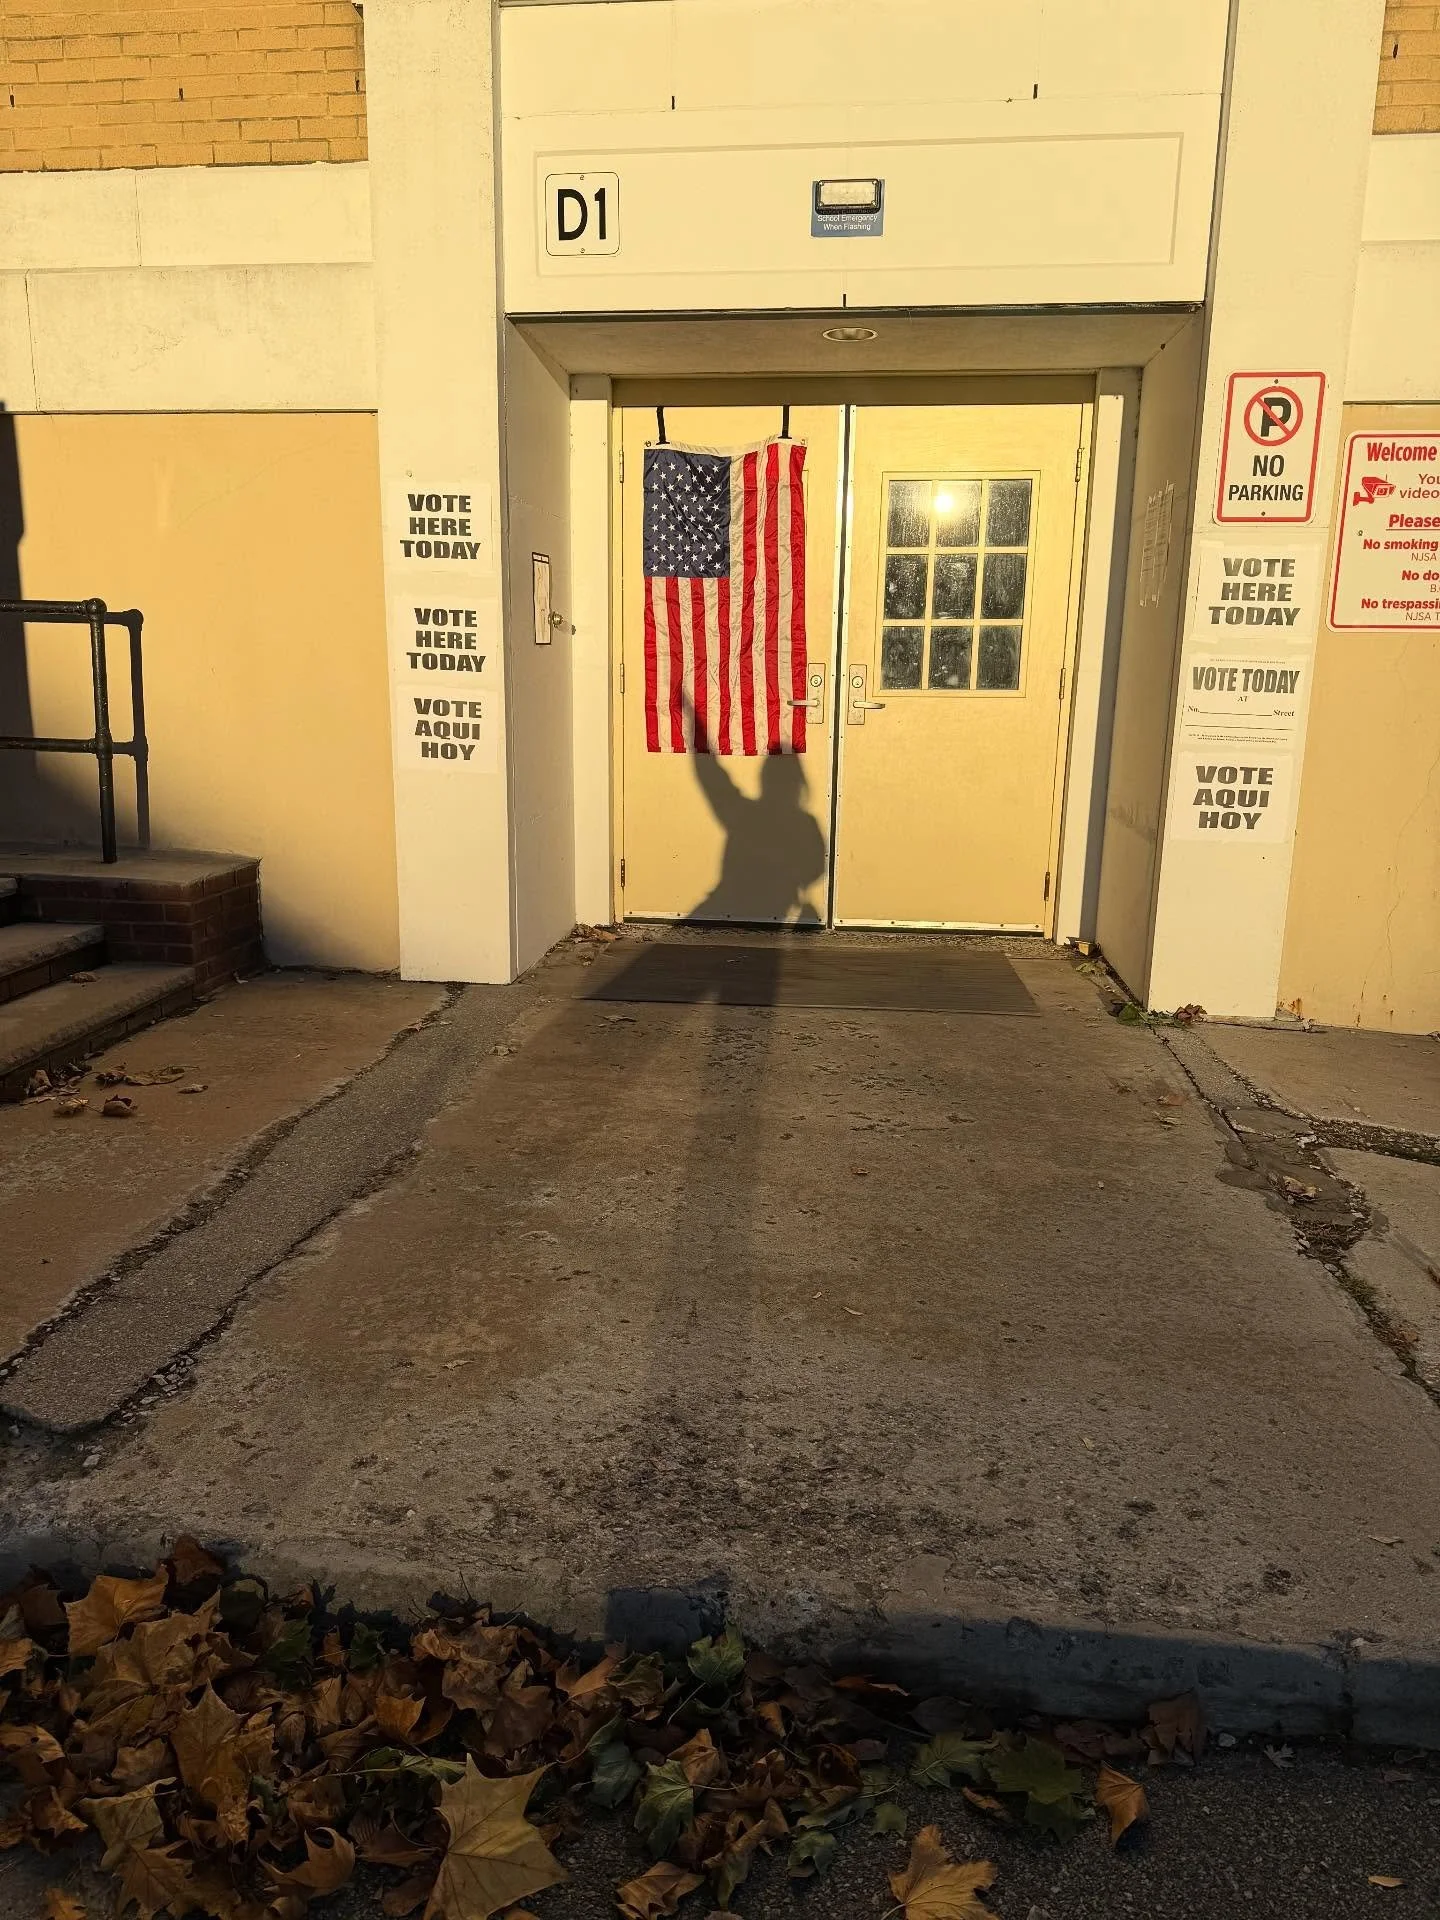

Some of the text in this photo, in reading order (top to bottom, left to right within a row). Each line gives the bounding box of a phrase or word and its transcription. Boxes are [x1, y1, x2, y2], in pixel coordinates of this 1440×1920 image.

[558, 188, 606, 240] D1
[818, 214, 840, 222] School
[844, 223, 871, 231] Flashing
[1367, 442, 1437, 461] Welcome
[1253, 455, 1284, 477] NO
[1229, 484, 1303, 501] PARKING
[1400, 487, 1440, 498] video
[408, 494, 471, 513] VOTE
[410, 517, 471, 536] HERE
[1389, 514, 1440, 527] Please
[400, 540, 481, 559] TODAY
[1363, 539, 1438, 551] No smoking
[1411, 553, 1436, 561] NJSA
[1223, 558, 1295, 577] VOTE
[1402, 570, 1419, 580] No
[1221, 582, 1292, 601] HERE
[1361, 599, 1378, 608] No
[414, 608, 477, 627] VOTE
[1209, 606, 1301, 626] TODAY
[1406, 610, 1431, 621] NJSA
[416, 631, 476, 650] HERE
[406, 652, 486, 672] TODAY
[1193, 667, 1300, 694] VOTE TODAY
[414, 698, 482, 718] VOTE
[1273, 709, 1295, 717] Street
[415, 720, 480, 740] AQUI
[421, 742, 475, 760] HOY
[1196, 766, 1273, 785] VOTE
[1193, 789, 1269, 808] AQUI
[1199, 811, 1262, 829] HOY
